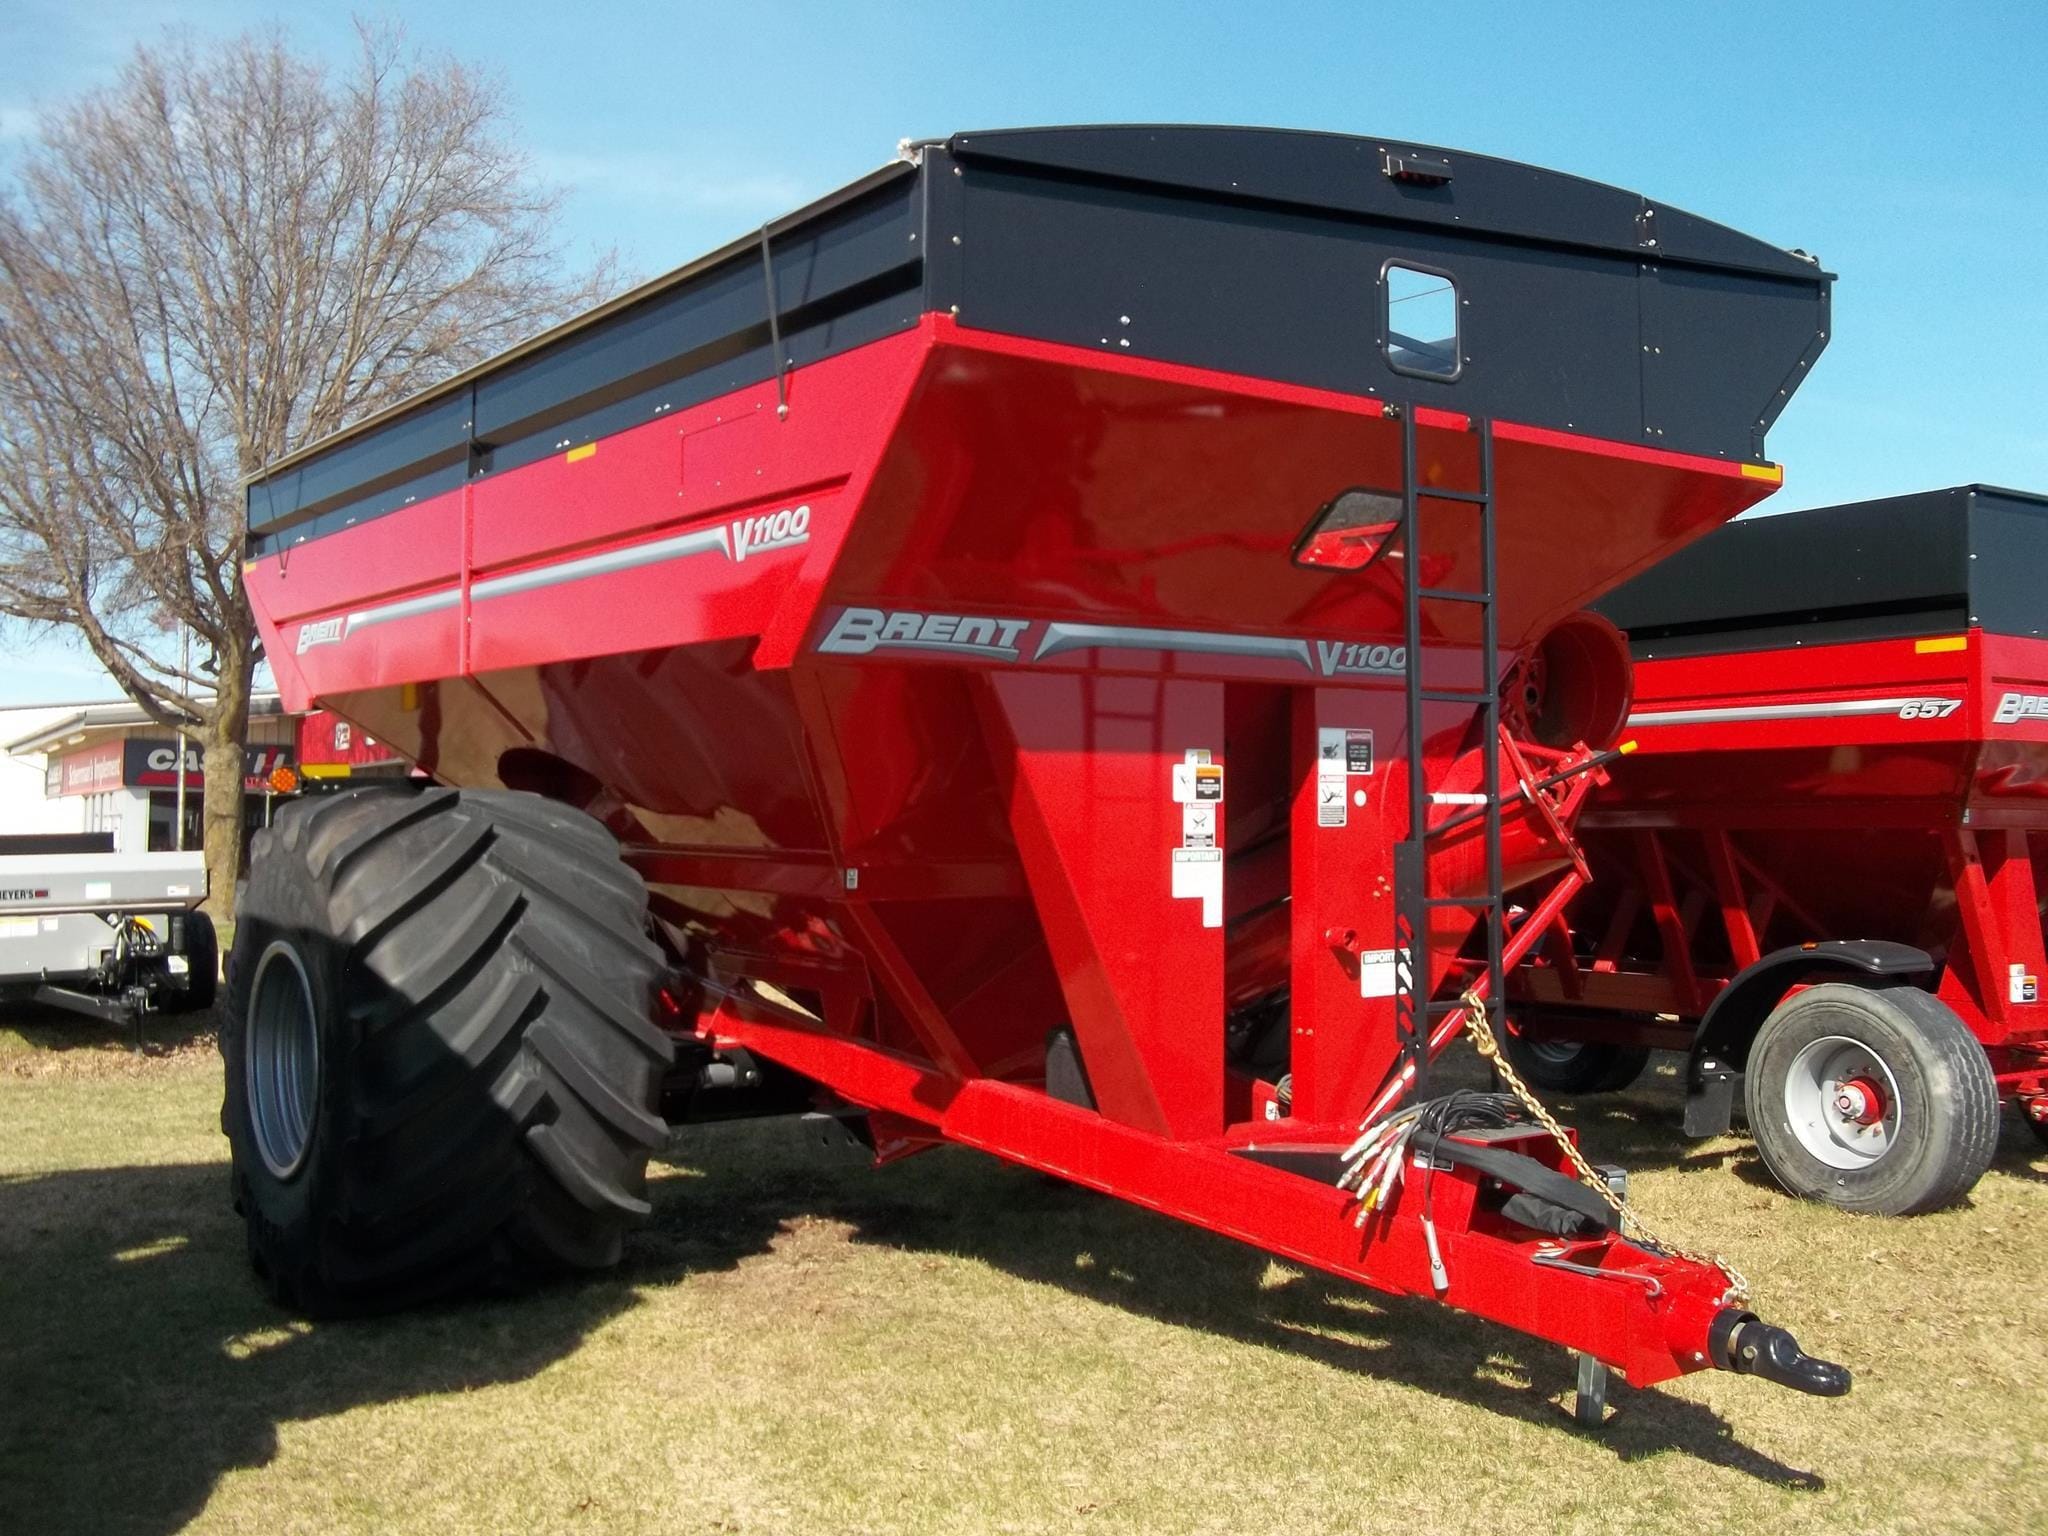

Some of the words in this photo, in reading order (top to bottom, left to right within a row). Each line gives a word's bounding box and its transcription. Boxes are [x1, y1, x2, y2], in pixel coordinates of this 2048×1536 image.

[733, 505, 810, 562] V1100
[817, 607, 1030, 655] BRENT
[1316, 640, 1406, 676] V1100
[1899, 699, 1963, 720] 657
[1992, 692, 2048, 724] BRE
